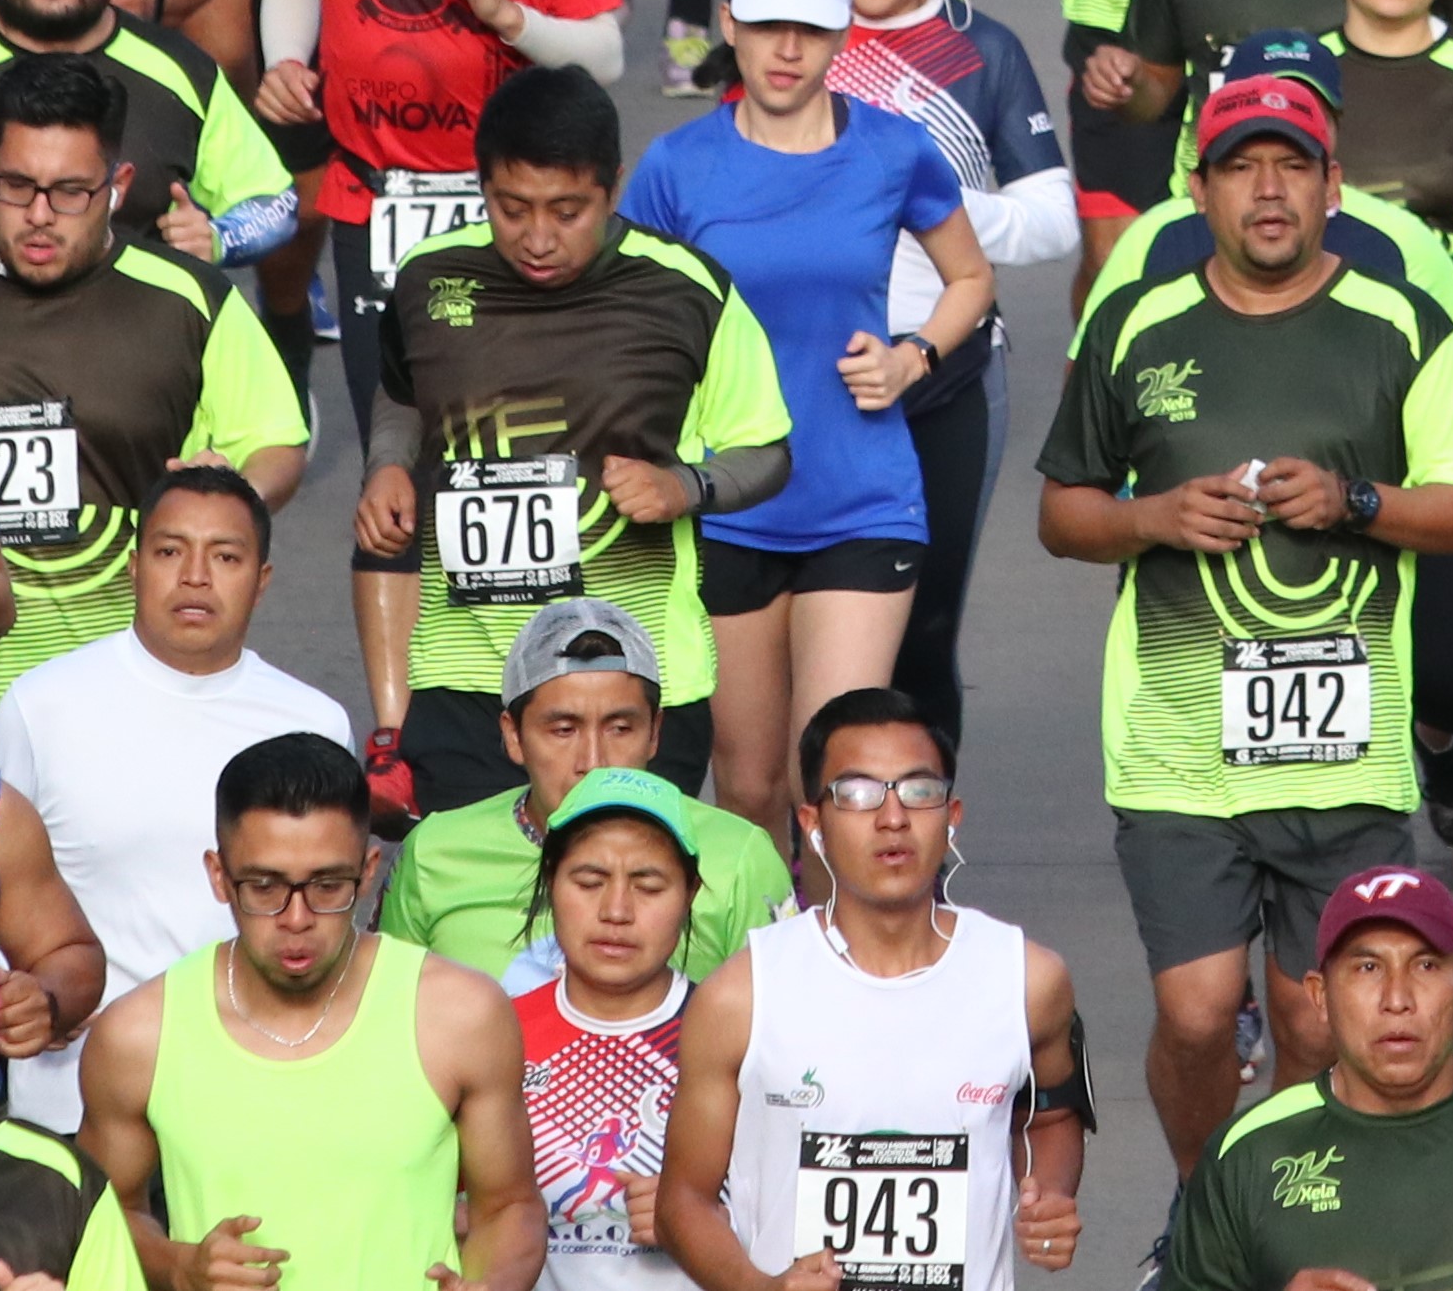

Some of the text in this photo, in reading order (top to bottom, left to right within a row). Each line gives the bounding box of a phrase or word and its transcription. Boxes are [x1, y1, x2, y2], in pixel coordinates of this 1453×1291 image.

[346, 76, 417, 101] GRUPO
[237, 192, 299, 245] SALVADO
[1161, 395, 1194, 412] Xela
[1169, 410, 1196, 423] 2019
[459, 493, 555, 567] 676
[490, 592, 533, 603] MEDALLA
[1246, 673, 1346, 742] 942
[859, 1140, 884, 1150] MEDIO
[1300, 1184, 1337, 1202] Xela
[1311, 1199, 1341, 1213] 2019
[822, 1177, 940, 1257] 943
